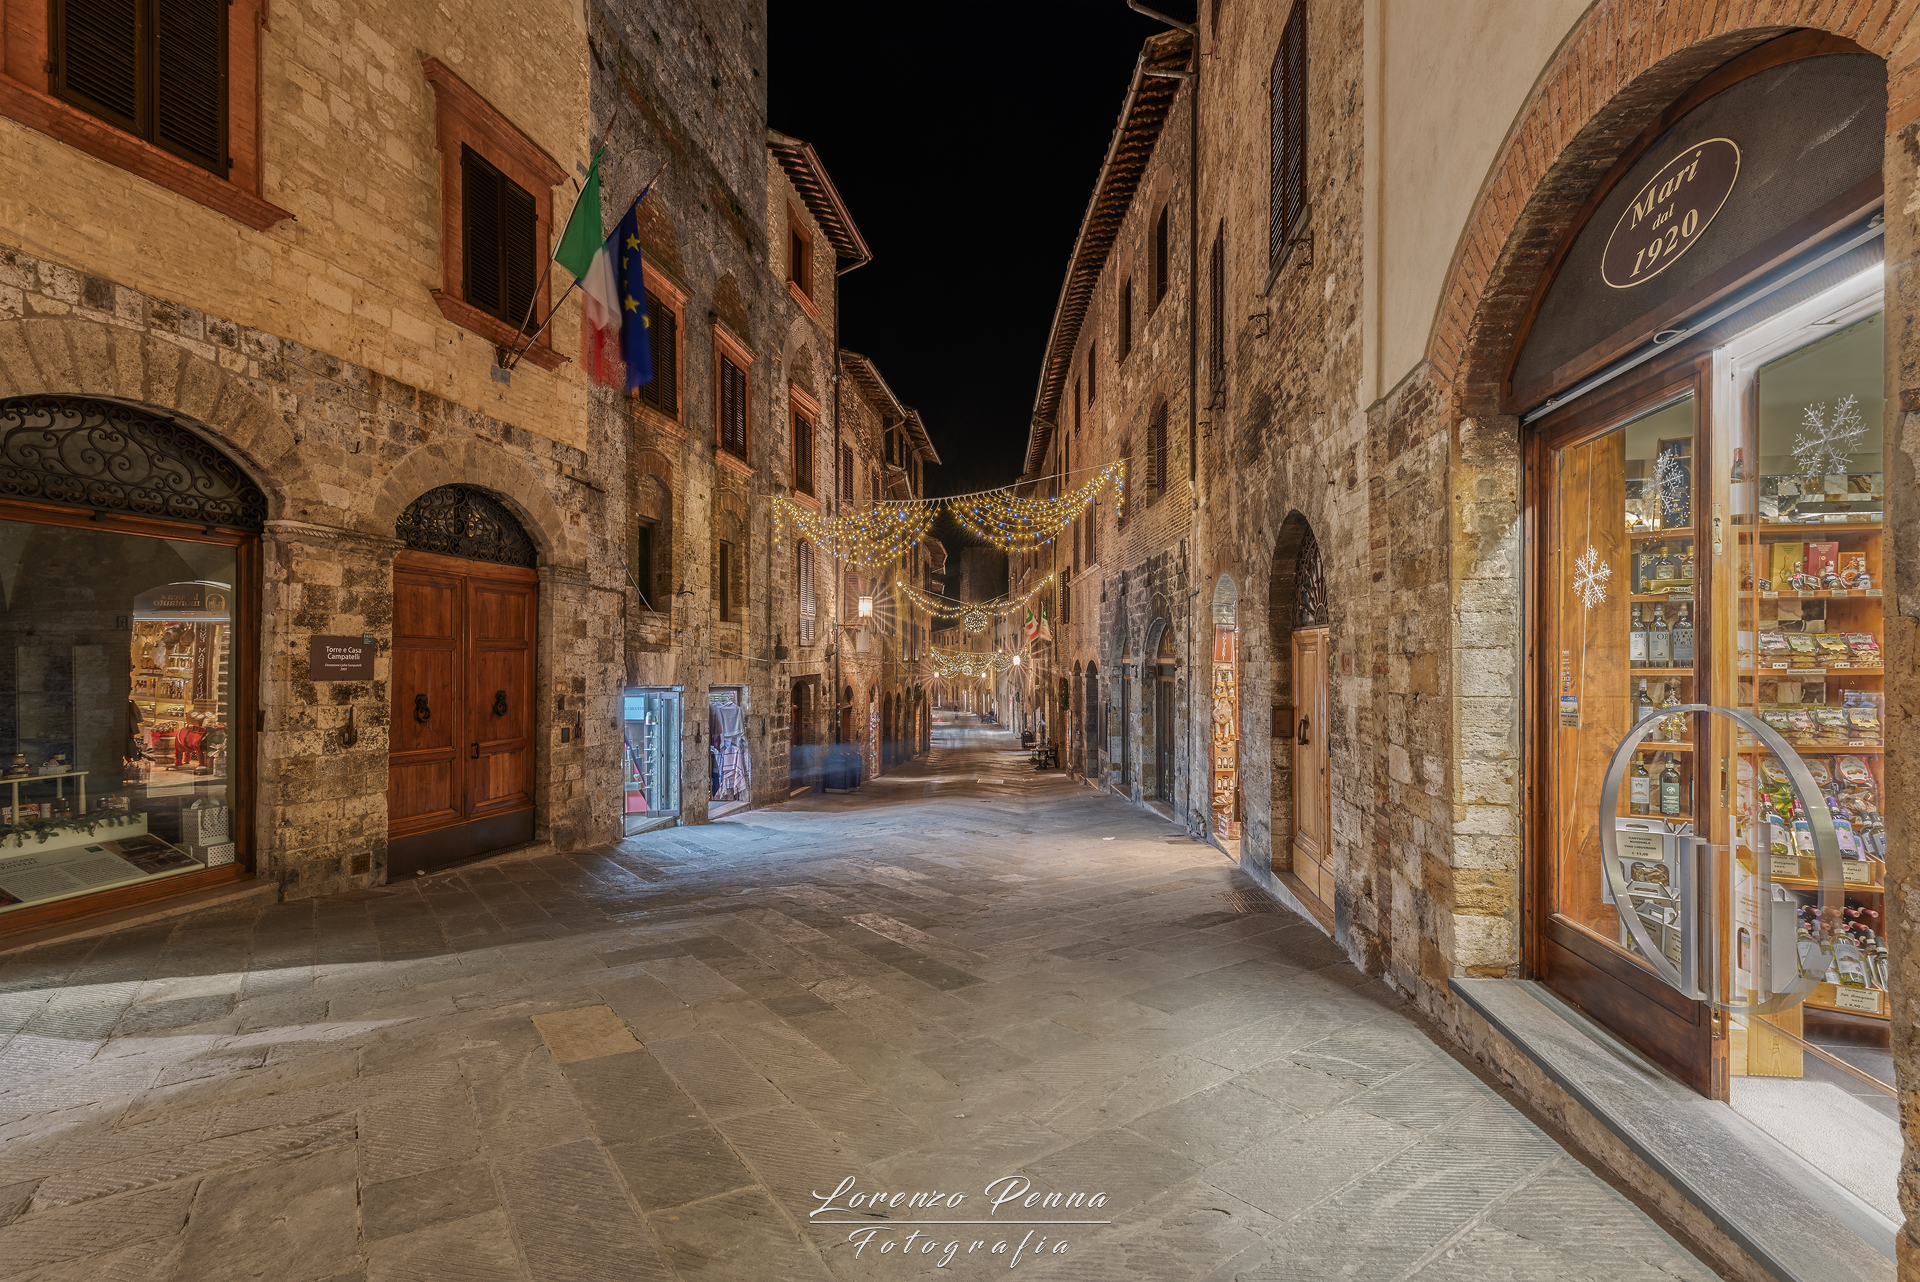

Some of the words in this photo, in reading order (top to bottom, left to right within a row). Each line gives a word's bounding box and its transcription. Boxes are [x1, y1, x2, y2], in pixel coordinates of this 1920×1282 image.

[1630, 150, 1702, 230] Mari
[1652, 202, 1675, 231] dal
[1629, 208, 1698, 278] 1920
[325, 645, 341, 653] Torre
[348, 646, 362, 654] Casa
[327, 653, 360, 661] Campatelli
[1851, 993, 1875, 1001] Gimignano
